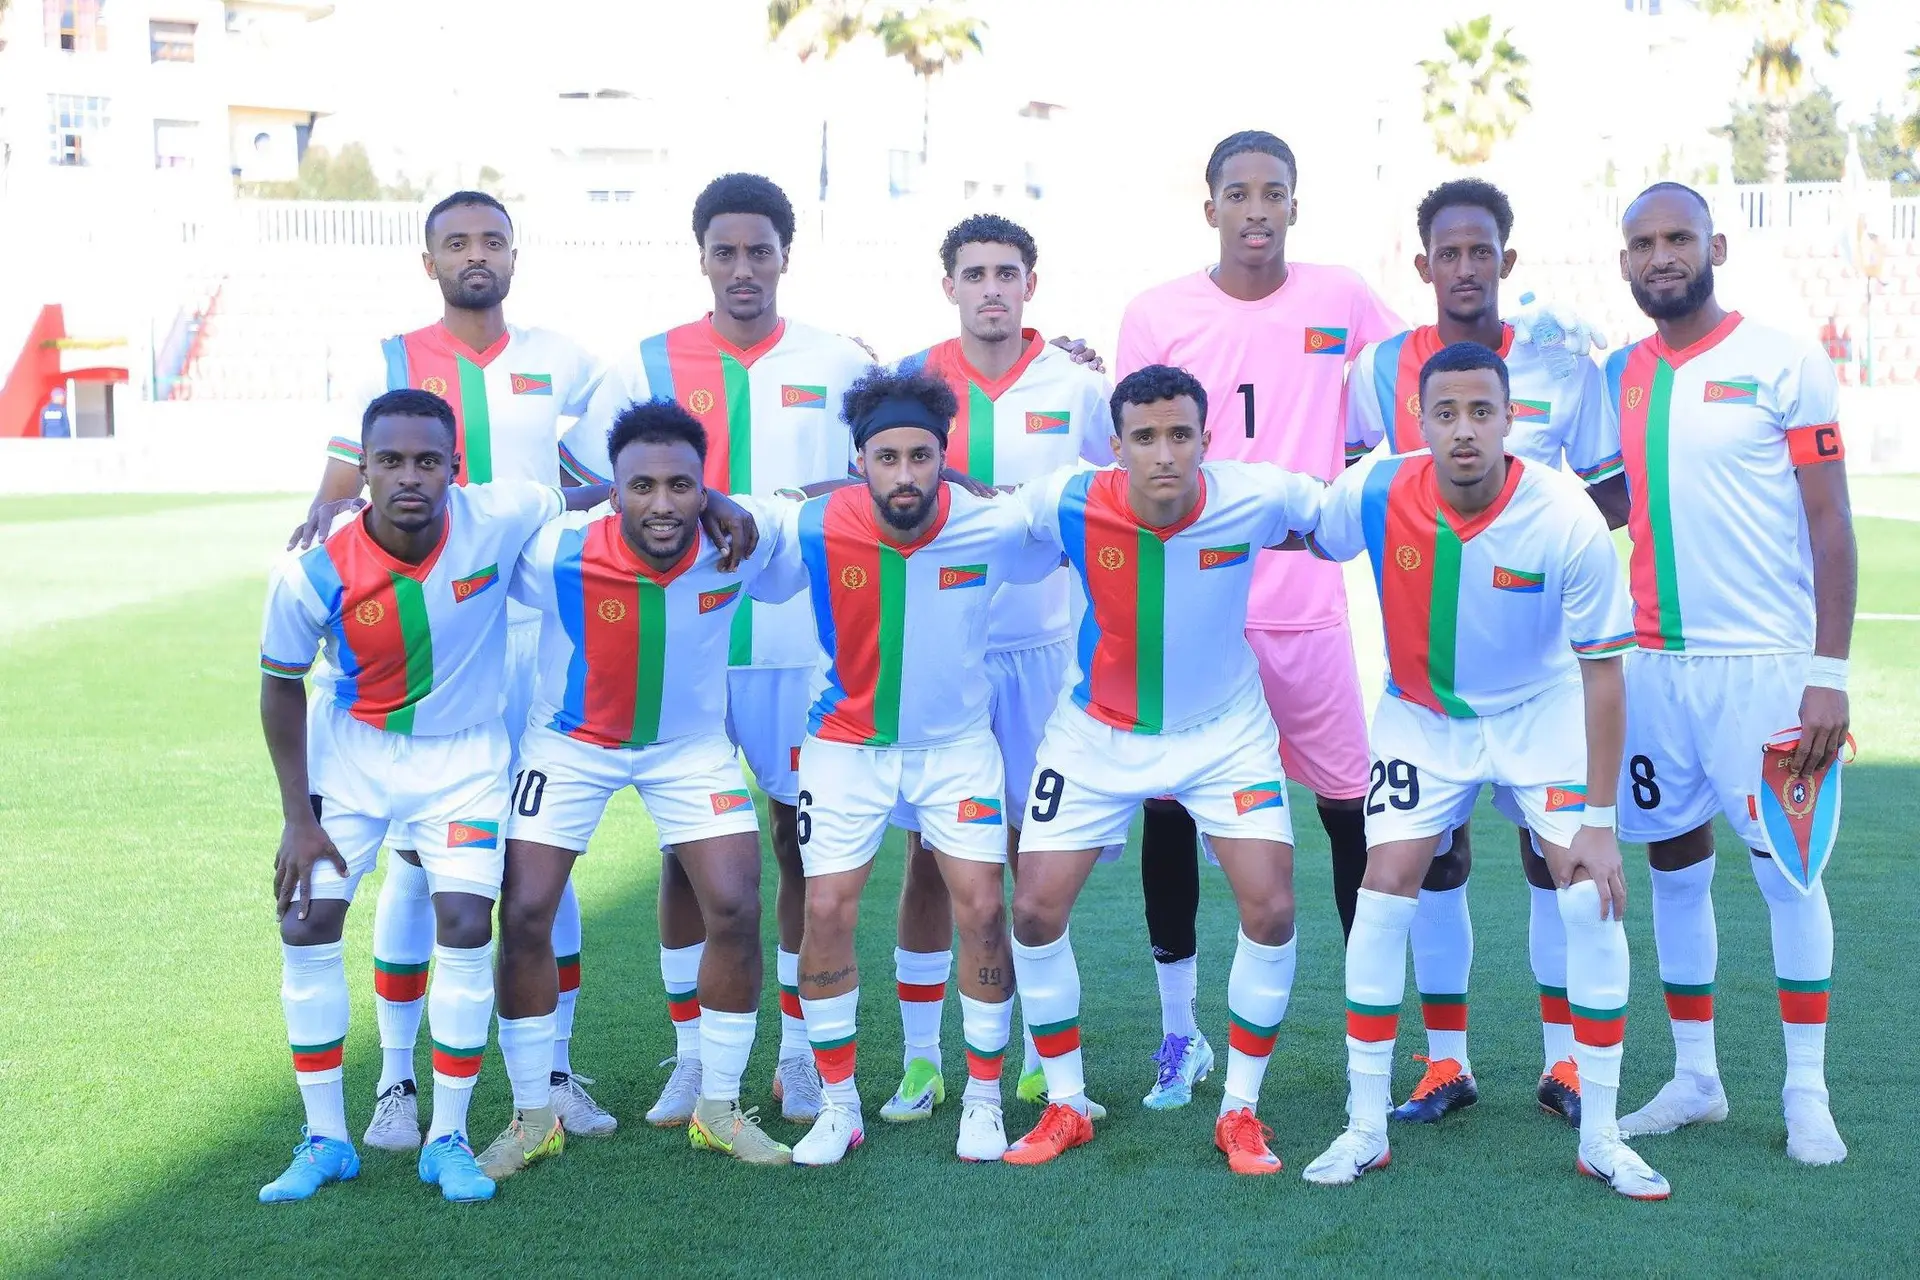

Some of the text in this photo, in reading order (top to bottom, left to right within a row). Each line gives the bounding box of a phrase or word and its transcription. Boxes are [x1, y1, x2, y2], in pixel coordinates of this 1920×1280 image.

[1236, 383, 1255, 439] 1
[1815, 427, 1839, 456] C
[509, 769, 548, 817] 10
[1031, 768, 1065, 823] 9
[1366, 758, 1420, 817] 29
[1629, 754, 1661, 810] 8
[797, 789, 813, 846] 6
